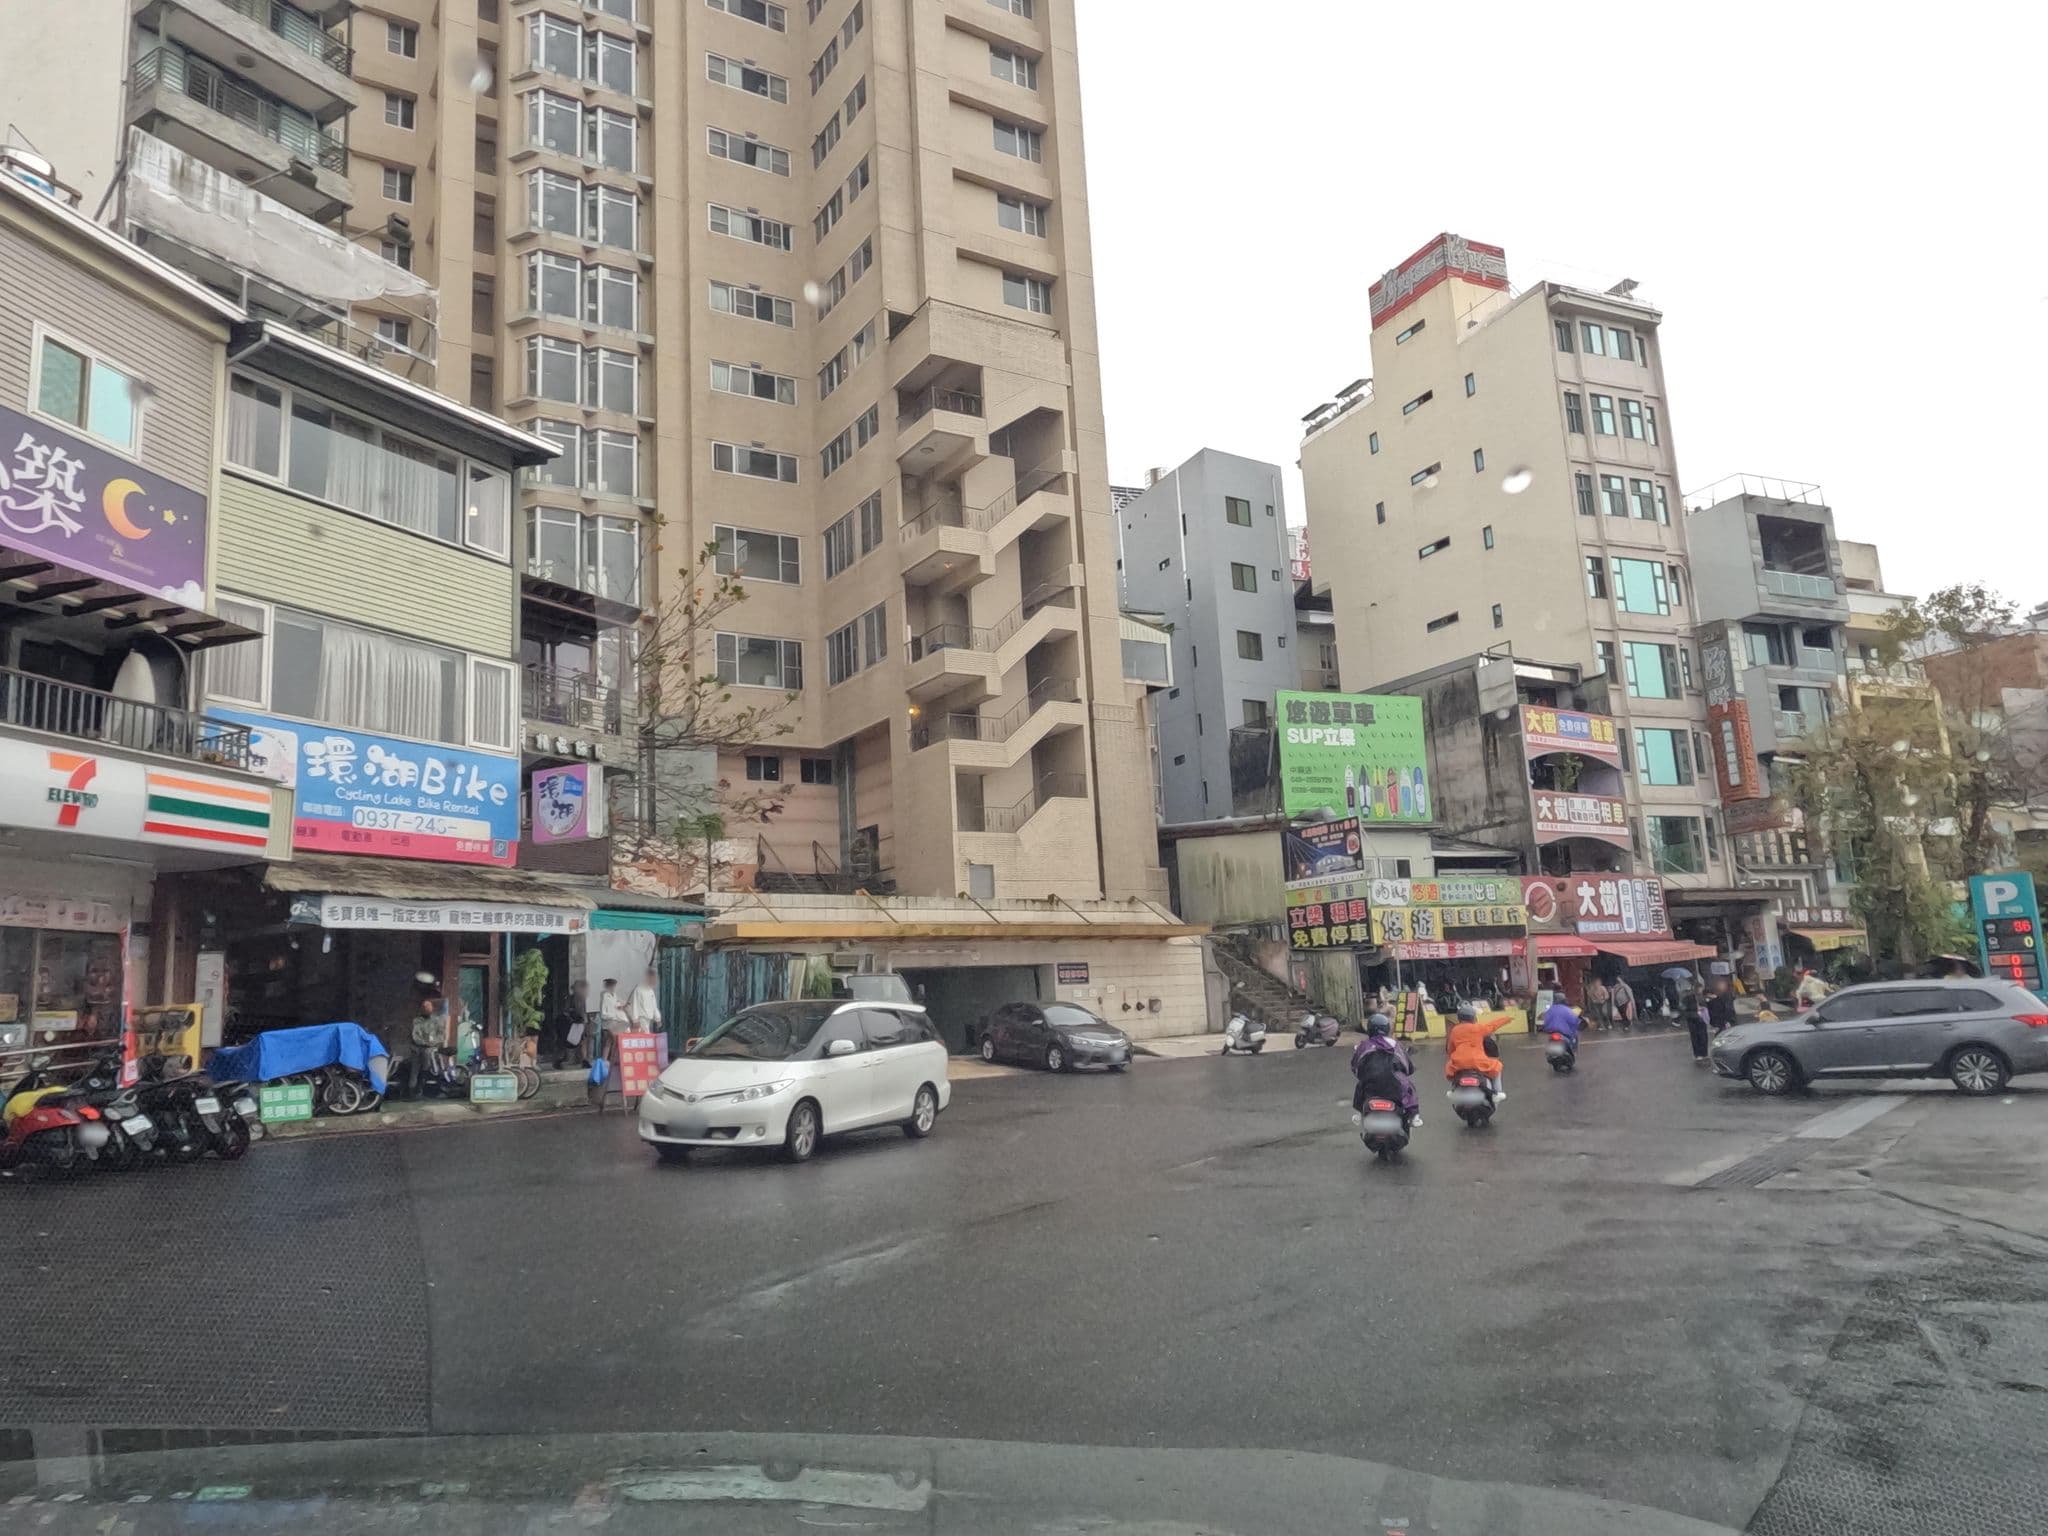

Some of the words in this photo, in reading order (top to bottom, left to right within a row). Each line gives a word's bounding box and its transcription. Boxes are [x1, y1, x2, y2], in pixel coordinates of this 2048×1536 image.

[0, 431, 88, 538] 築
[335, 787, 381, 804] Cycling
[384, 793, 412, 806] Lake
[417, 797, 440, 810] Bike
[443, 801, 479, 815] Rental
[1330, 900, 1367, 923] 租車
[1577, 880, 1619, 917] 大樹
[1983, 880, 2018, 915] P
[1293, 923, 1369, 949] 免費停車
[1382, 909, 1434, 941] 悠遊
